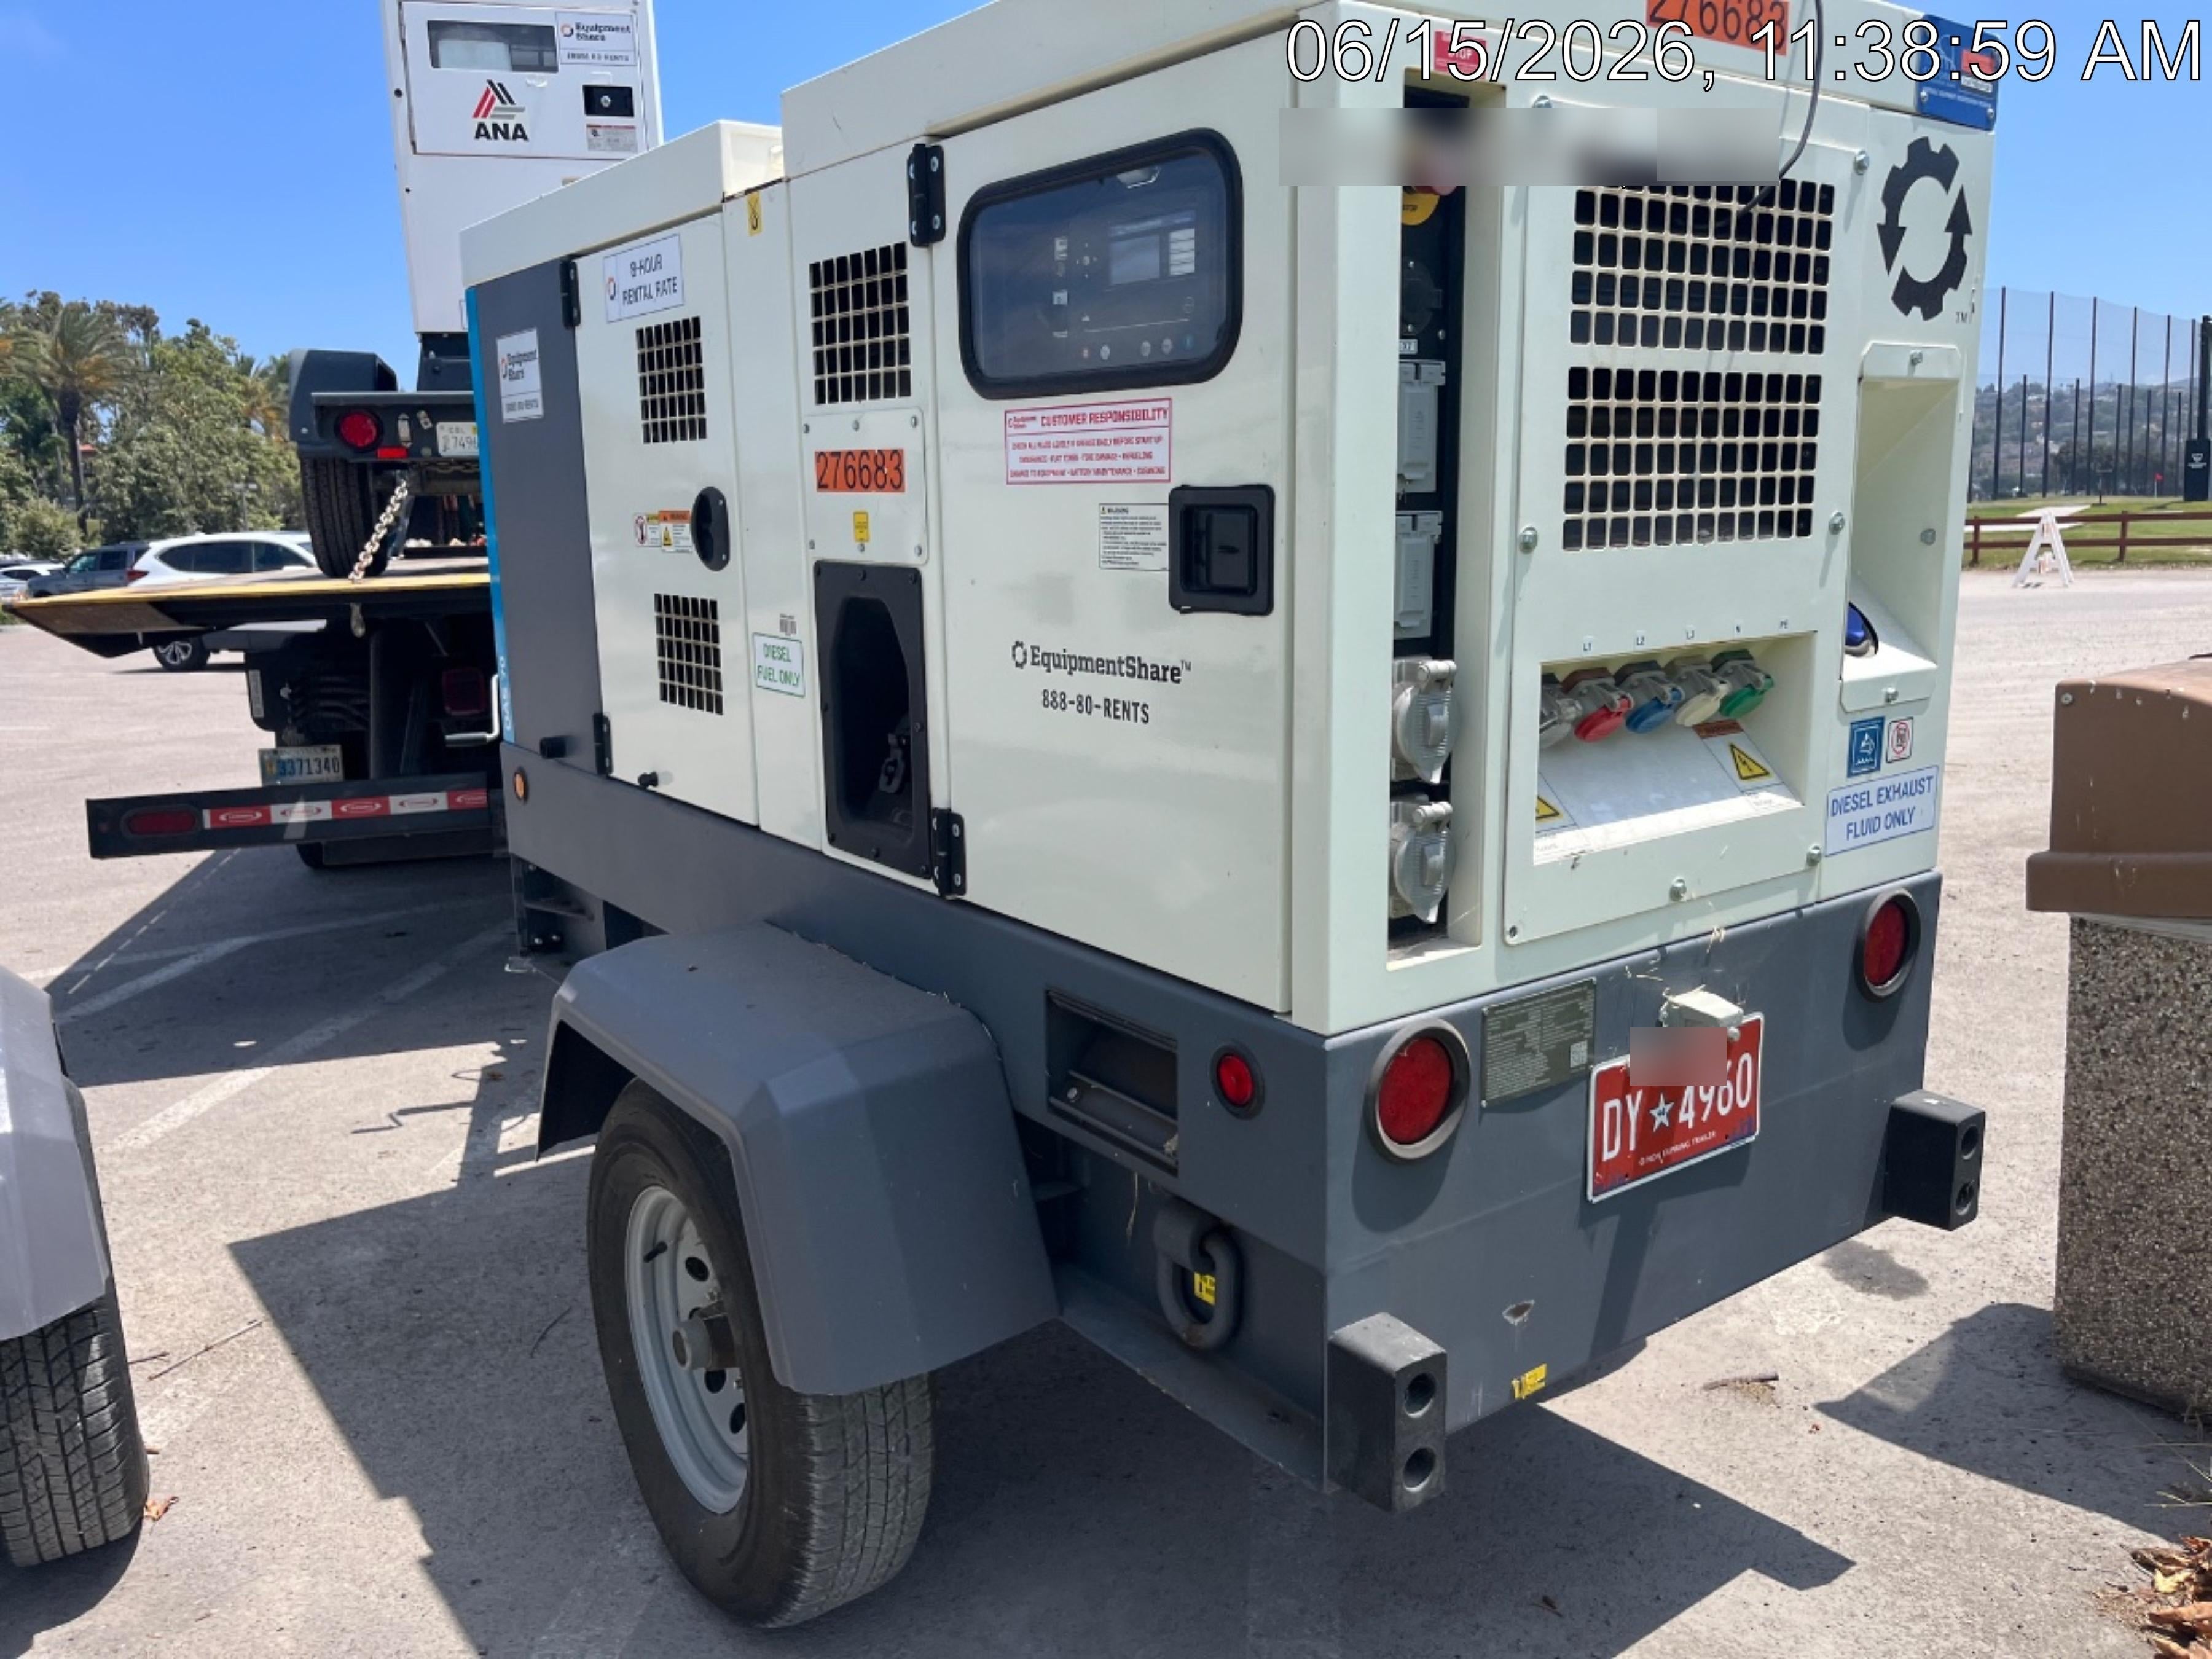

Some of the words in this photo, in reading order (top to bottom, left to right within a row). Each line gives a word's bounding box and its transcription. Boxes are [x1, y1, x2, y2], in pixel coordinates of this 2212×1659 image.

[474, 122, 529, 142] ANA
[622, 284, 653, 307] RENTAL
[656, 276, 677, 297] RATE
[1041, 412, 1087, 427] CUSTOMER
[1089, 407, 1167, 424] RESPONSIBILITY
[817, 452, 903, 490] 276683
[763, 643, 792, 663] DIESEL
[1583, 643, 1592, 651] L1
[1636, 636, 1645, 646] L2
[757, 665, 778, 683] FUEL
[779, 669, 801, 688] ONLY
[1042, 689, 1150, 724] 888-80-RENTS
[1830, 790, 1873, 817] DIESEL
[1877, 775, 1934, 805] EXHAUST
[1846, 816, 1881, 841] FLUID
[1884, 806, 1916, 830] ONLY
[1602, 1089, 1642, 1162] DY
